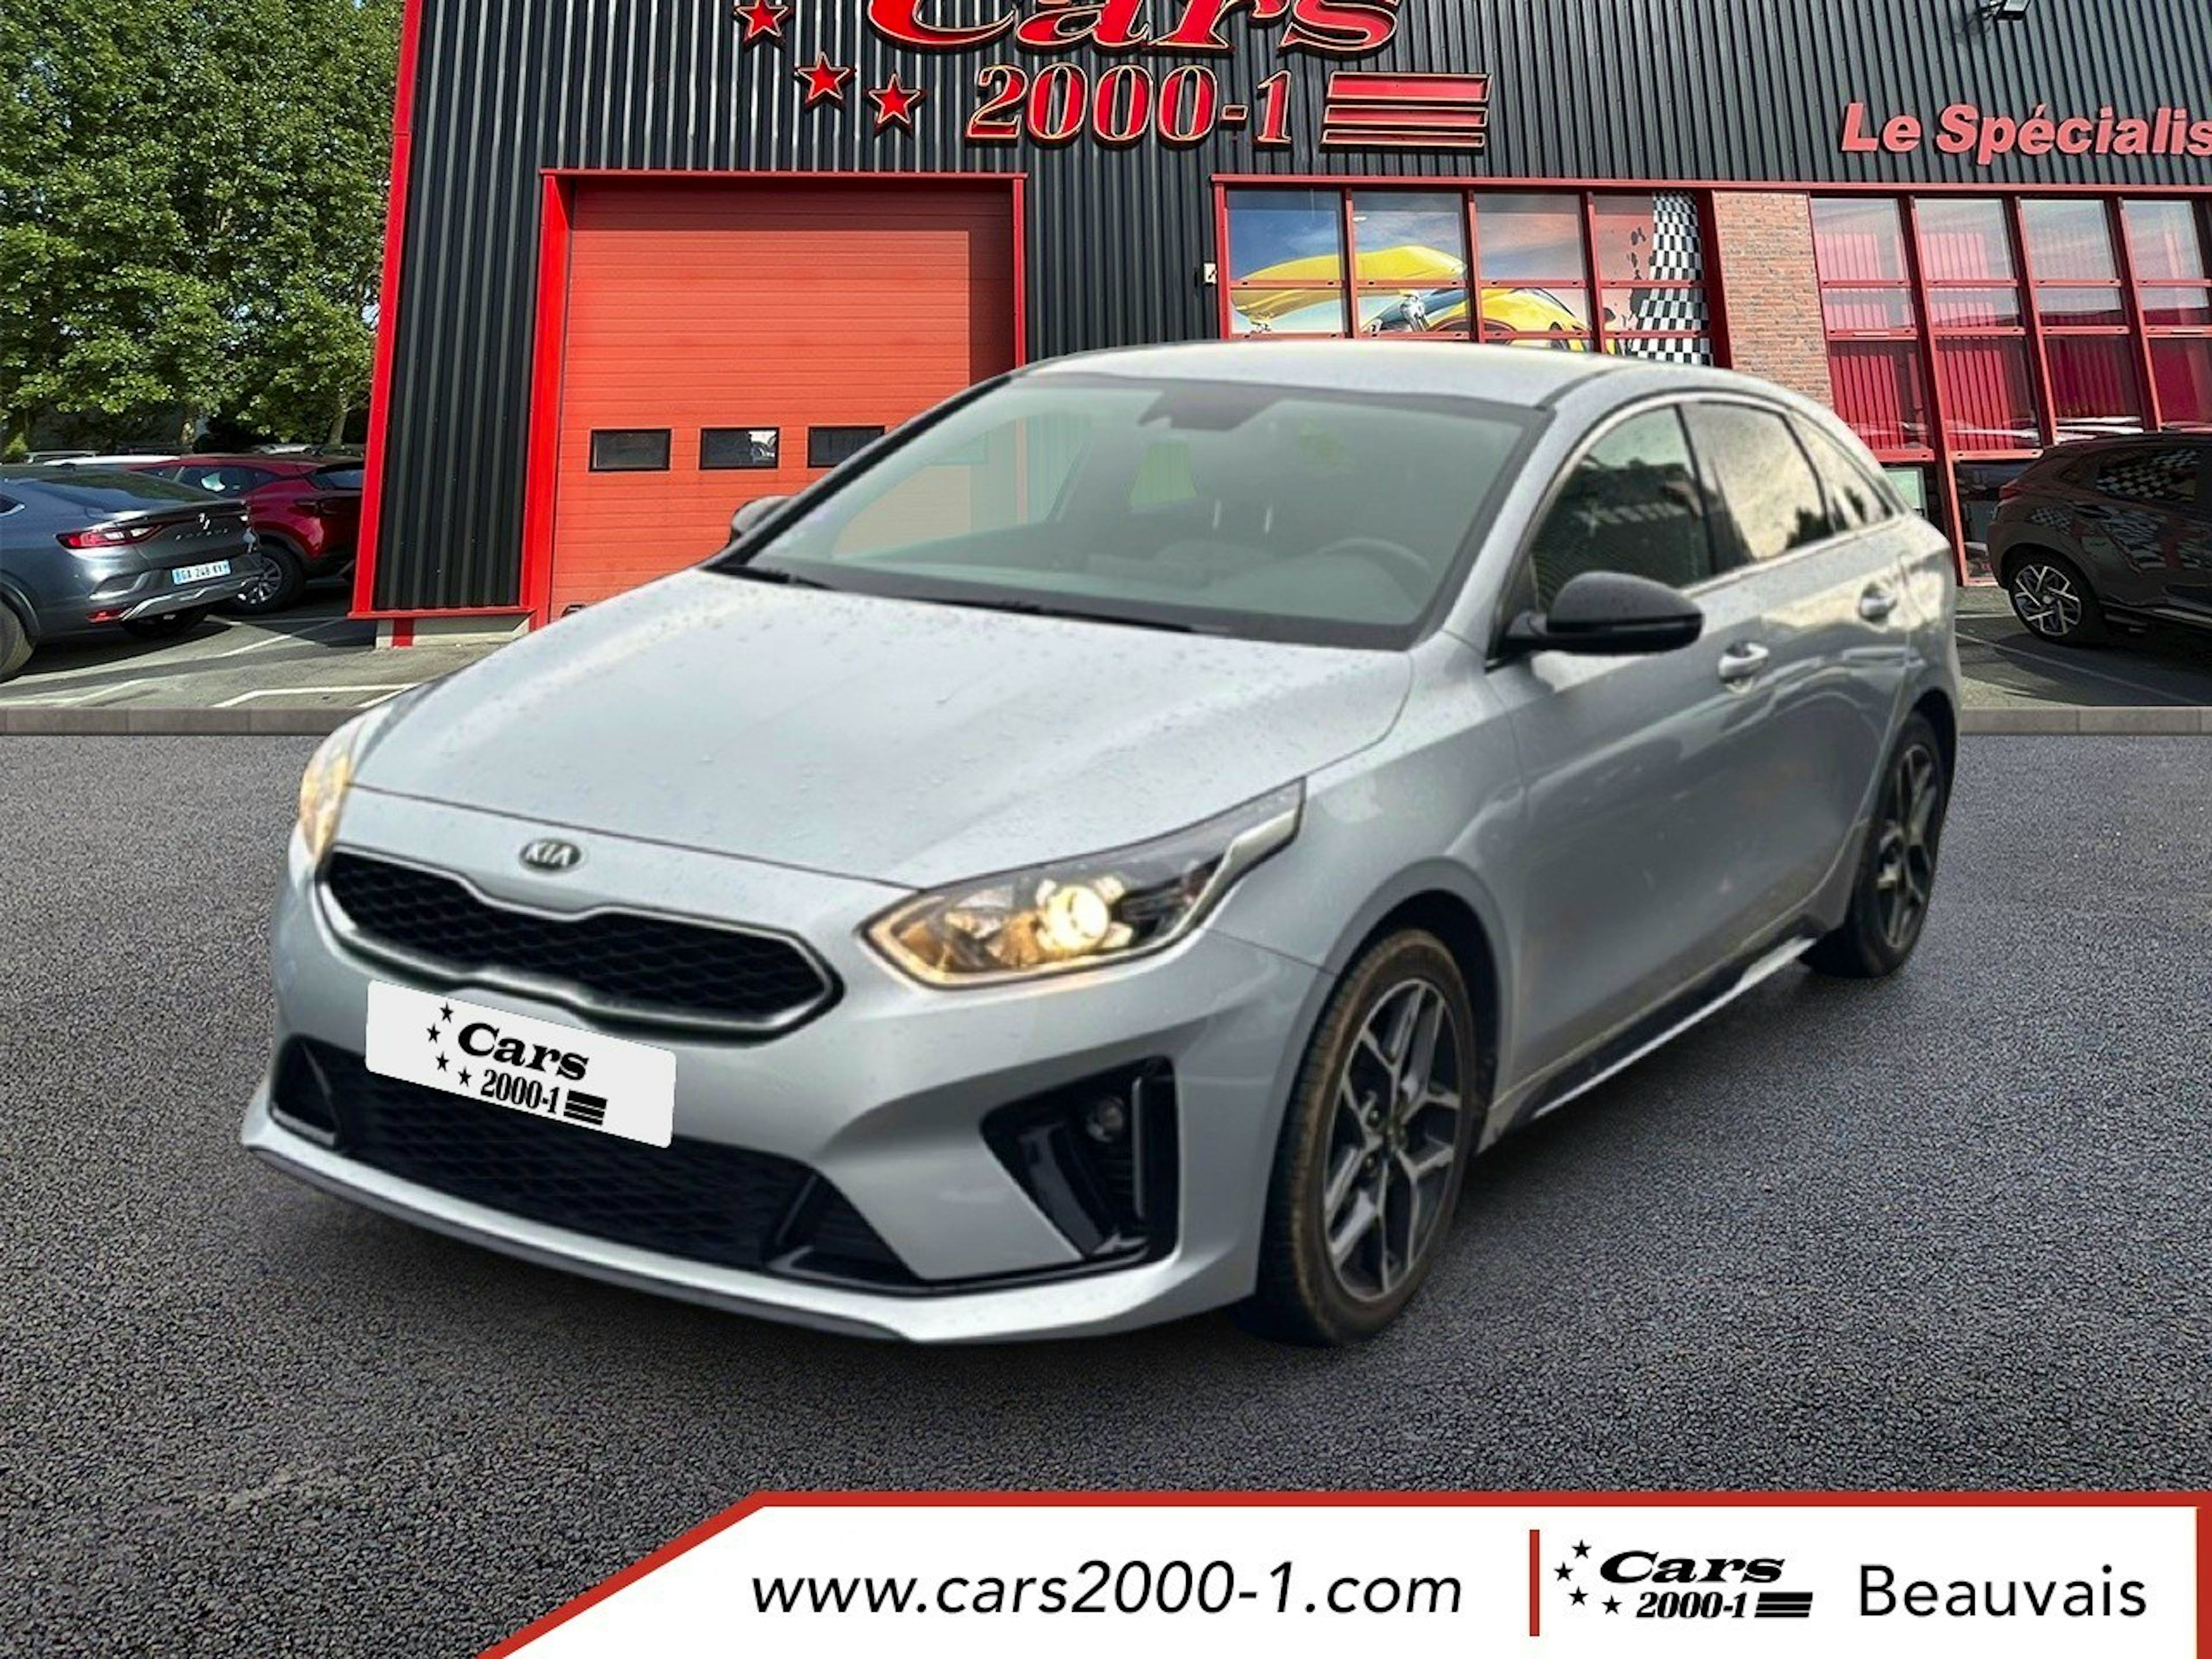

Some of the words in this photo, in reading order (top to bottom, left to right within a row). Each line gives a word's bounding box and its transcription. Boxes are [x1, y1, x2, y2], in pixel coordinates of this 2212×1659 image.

[965, 62, 1293, 145] 2000-1
[1842, 102, 1922, 153] Le
[1936, 102, 2212, 165] Spécialis
[525, 843, 572, 866] KIA
[458, 1022, 589, 1080] Cars
[480, 1069, 559, 1113] 2000-1
